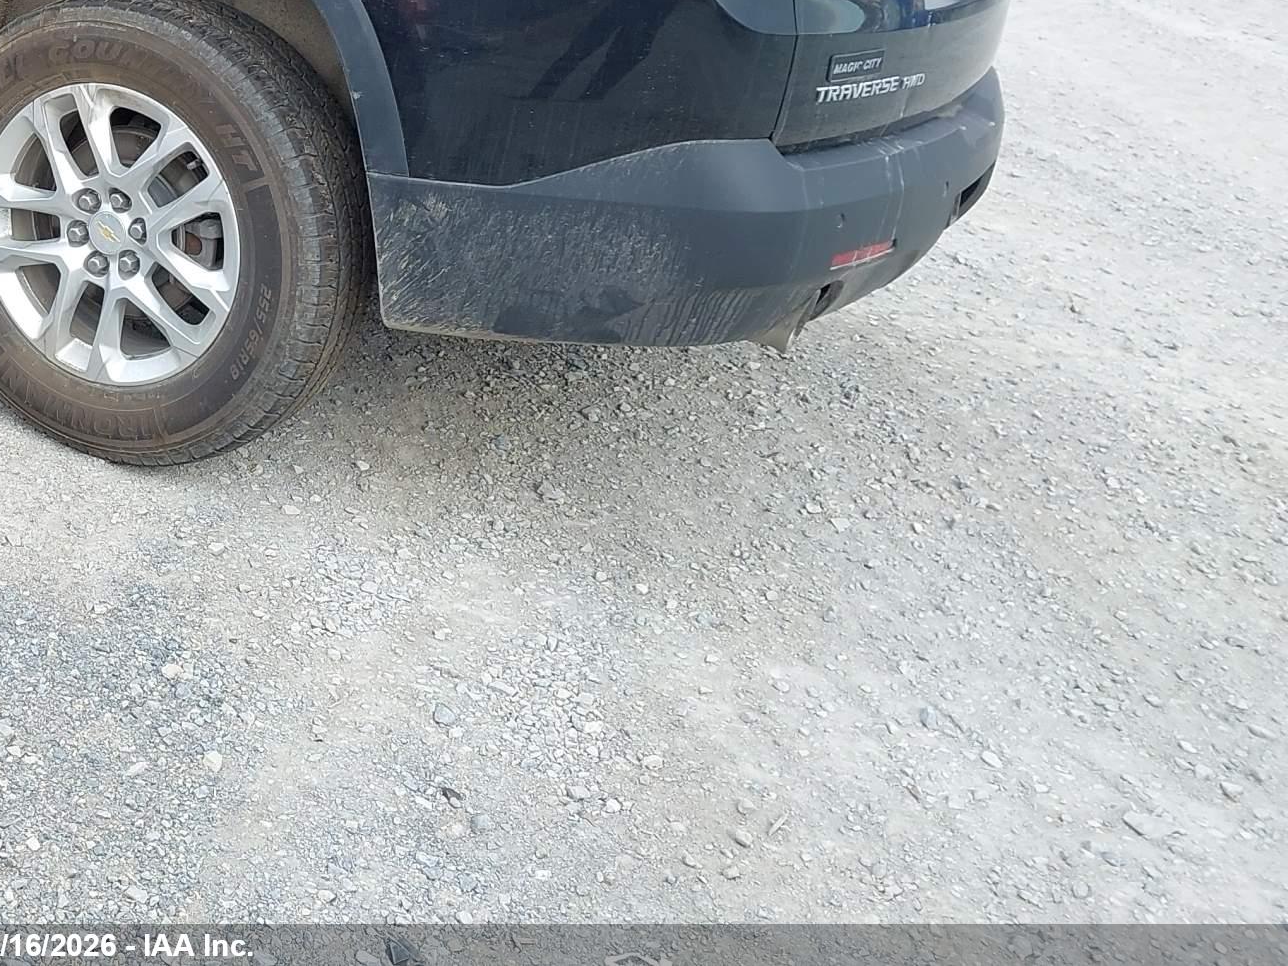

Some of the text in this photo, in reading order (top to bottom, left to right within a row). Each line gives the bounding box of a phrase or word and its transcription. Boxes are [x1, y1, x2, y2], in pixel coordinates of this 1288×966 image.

[833, 57, 882, 75] MAGIC CITY
[816, 76, 900, 103] TRAVERSE
[229, 282, 272, 381] 255/65R18
